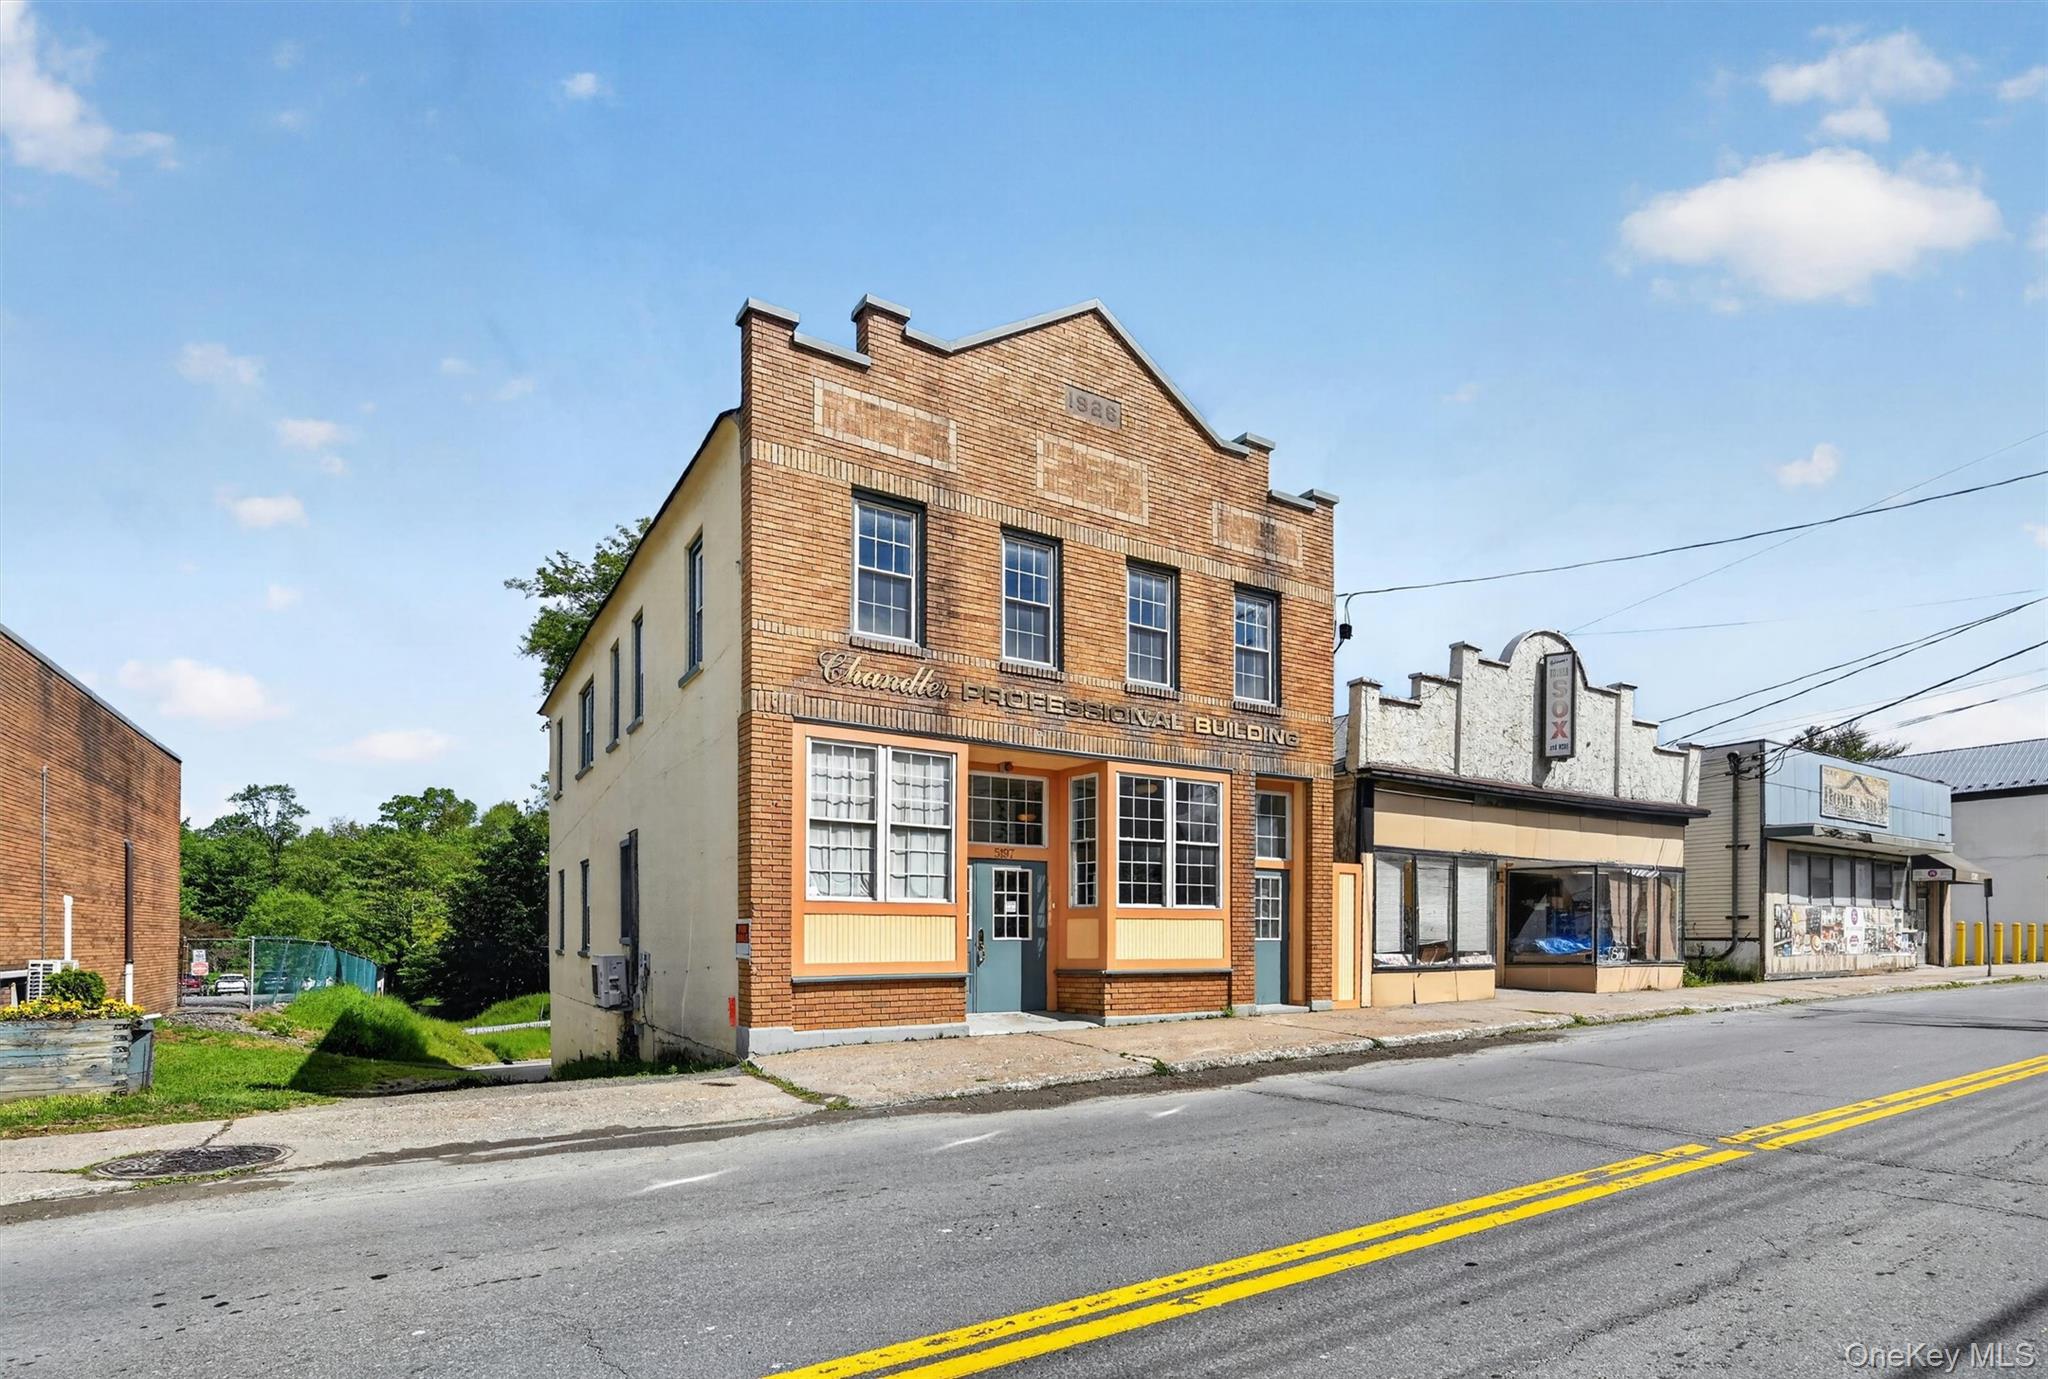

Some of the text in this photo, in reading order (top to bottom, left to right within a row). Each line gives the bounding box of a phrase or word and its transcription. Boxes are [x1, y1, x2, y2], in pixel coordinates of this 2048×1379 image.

[1068, 391, 1117, 423] 1926
[817, 650, 1301, 747] Chandler PROFESSIONAL BUILDING
[1552, 680, 1569, 739] SOX
[994, 847, 1016, 859] 5197
